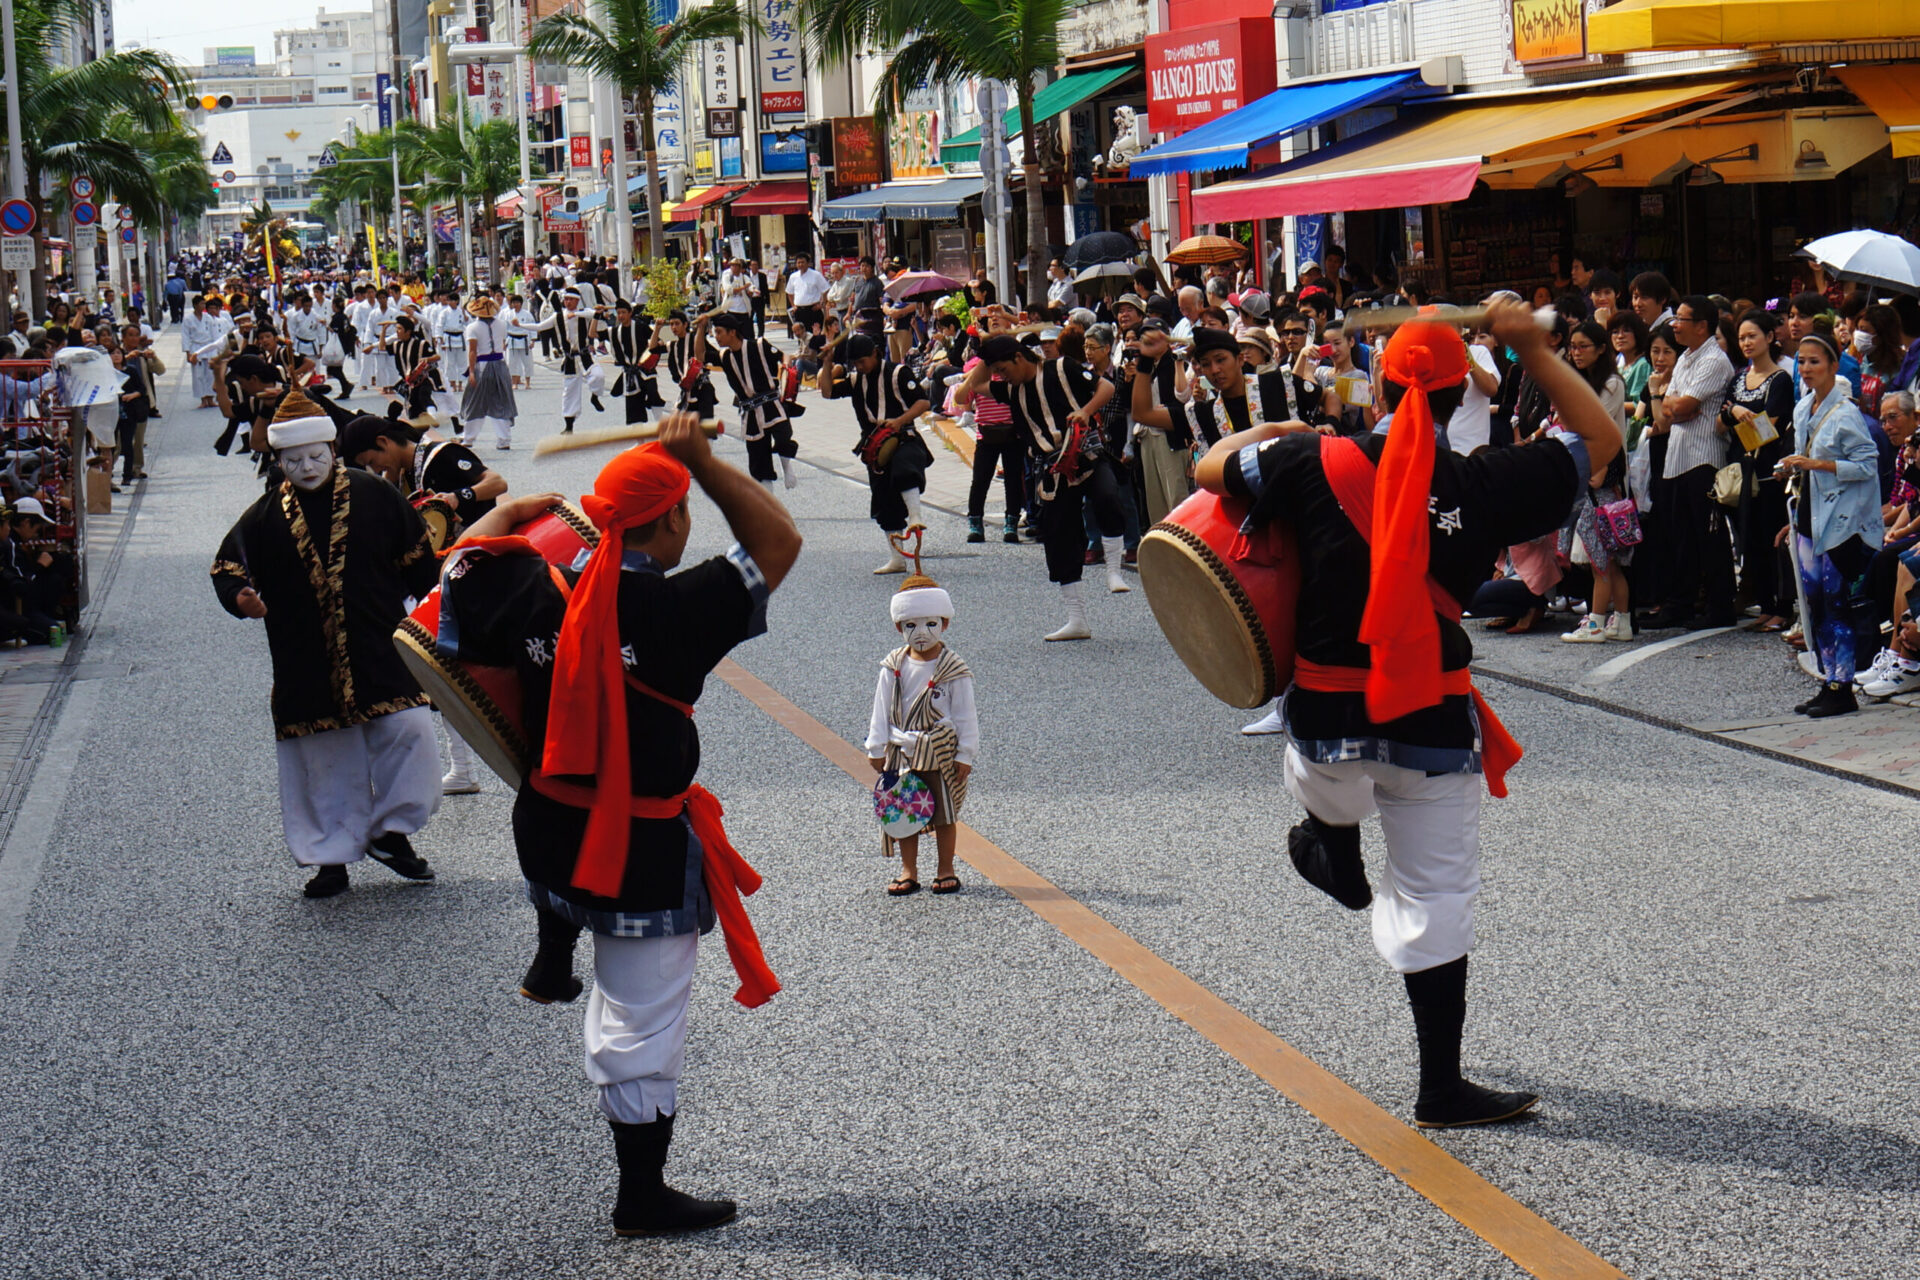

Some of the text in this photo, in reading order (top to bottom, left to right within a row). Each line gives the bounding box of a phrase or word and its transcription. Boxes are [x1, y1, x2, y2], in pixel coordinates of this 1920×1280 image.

[763, 0, 796, 82] 伊勢エビ
[713, 41, 728, 104] 塩の専門店
[1152, 58, 1237, 102] MANGO HOUSE
[840, 168, 878, 183] Ohana
